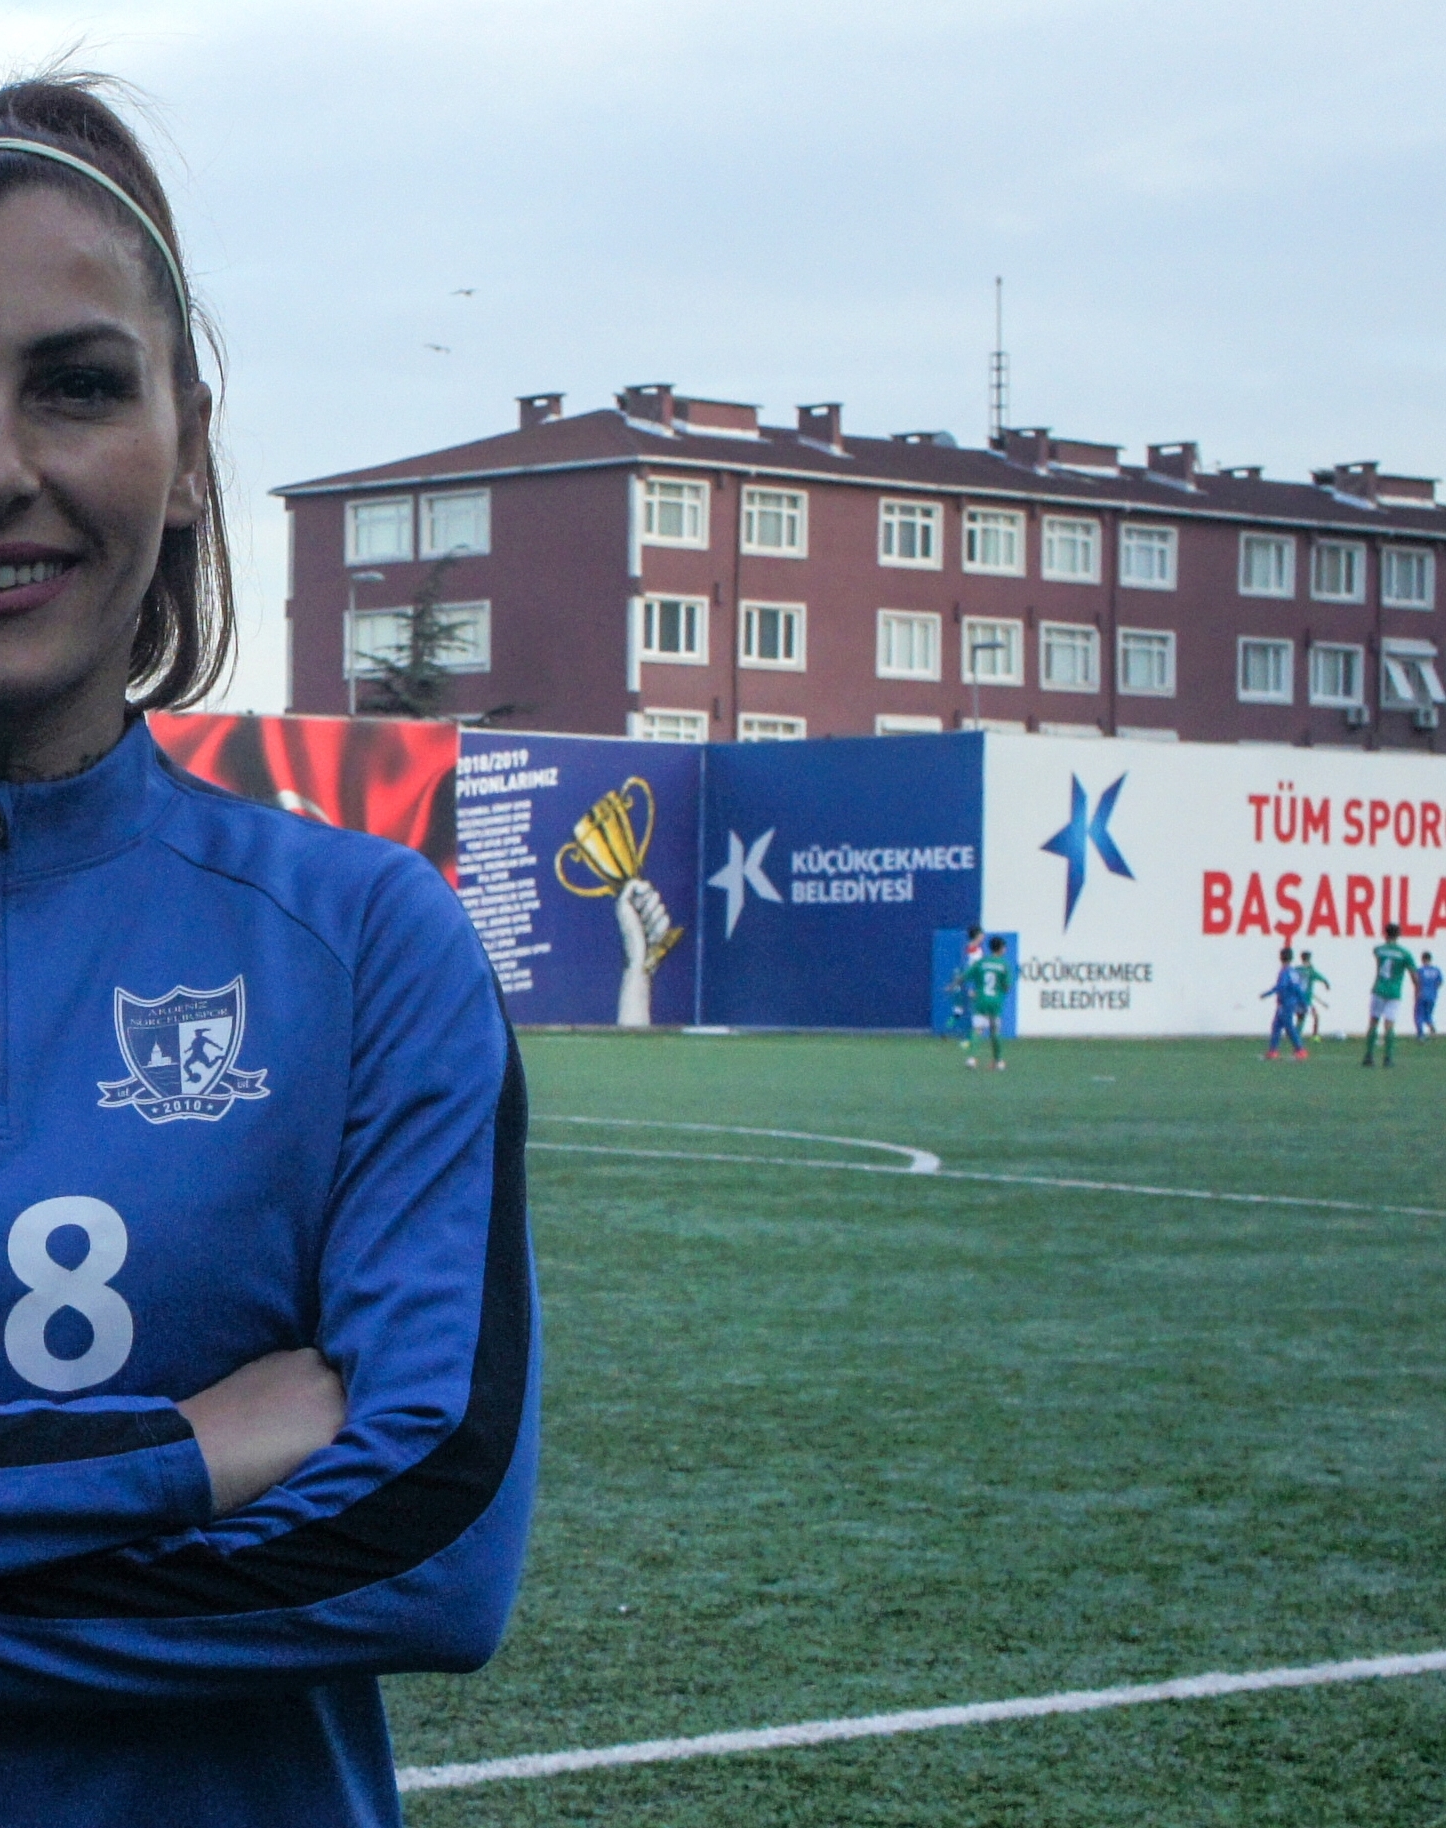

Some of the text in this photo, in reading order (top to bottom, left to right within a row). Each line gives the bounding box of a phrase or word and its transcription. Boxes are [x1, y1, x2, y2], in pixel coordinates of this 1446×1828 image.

[1248, 781, 1446, 848] TÜM SPOR
[791, 844, 975, 876] KÜÇÜKÇEKMECE
[791, 873, 914, 904] BELEDİYESİ
[982, 970, 997, 997] 2
[1039, 985, 1132, 1010] BELEDİYESİ
[163, 1100, 202, 1114] 2010
